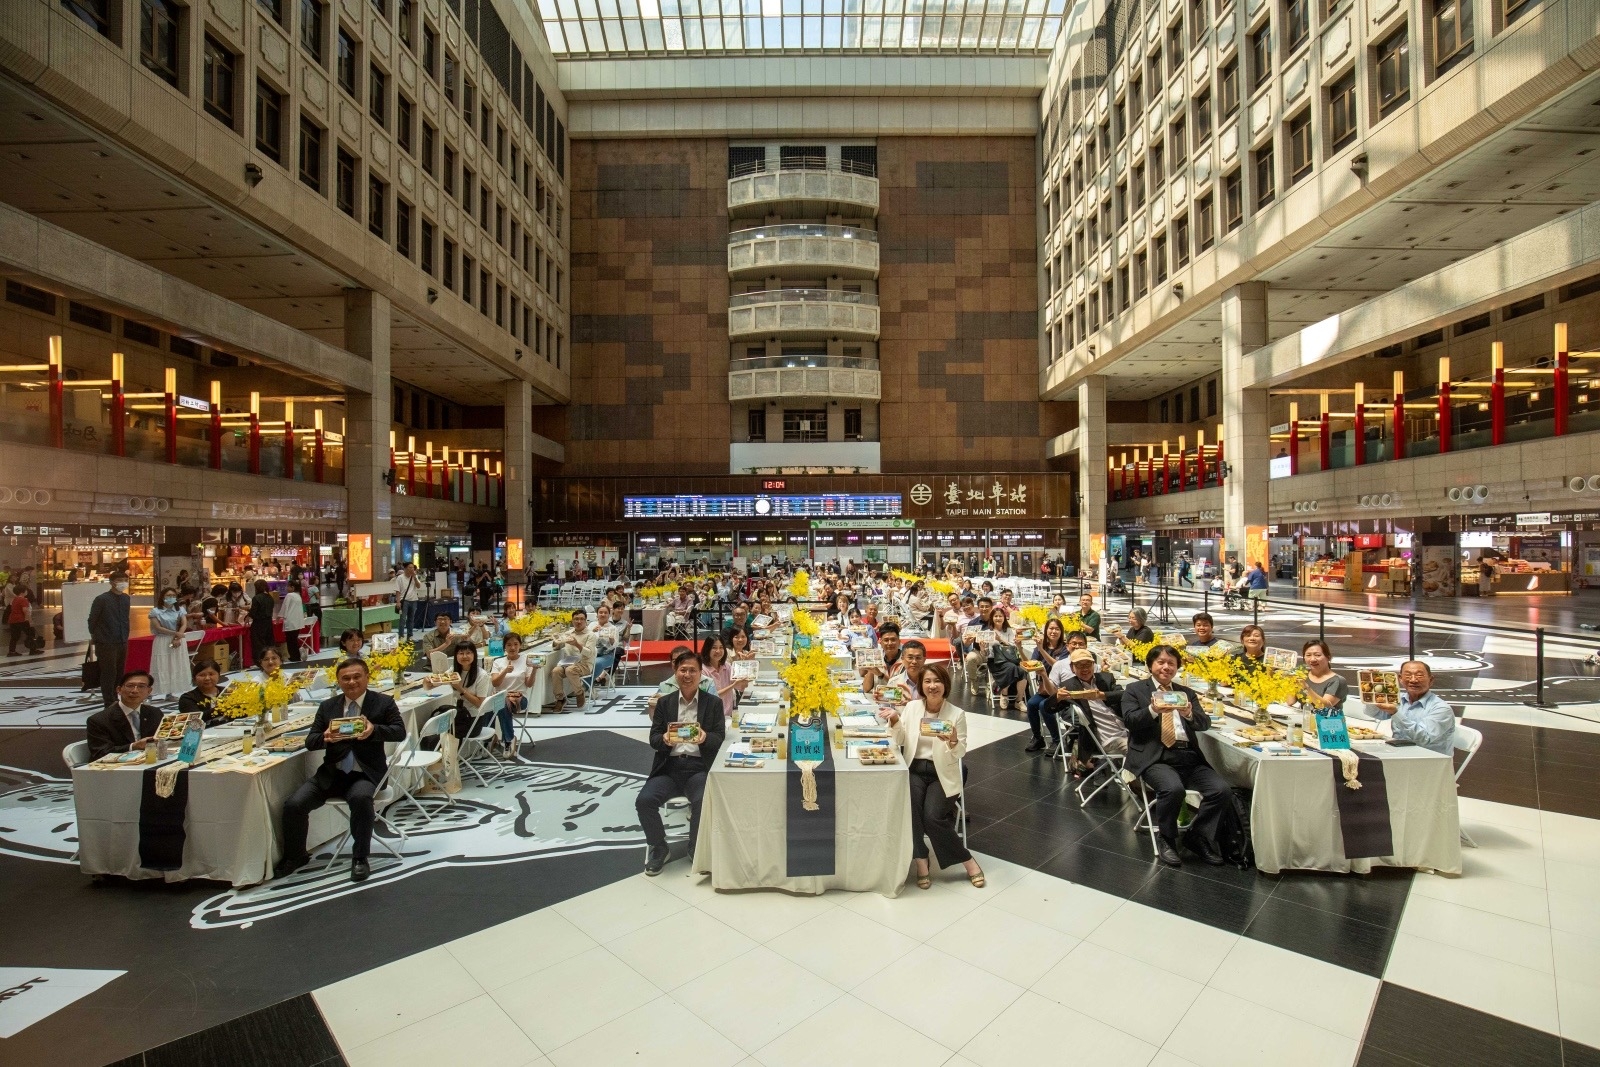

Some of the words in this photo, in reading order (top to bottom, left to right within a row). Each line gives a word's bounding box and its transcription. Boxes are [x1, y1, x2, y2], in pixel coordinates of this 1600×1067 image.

[764, 481, 785, 489] 12:04
[943, 481, 1027, 506] 臺北車站
[946, 508, 969, 516] TAIPEI
[972, 508, 992, 516] MAIN
